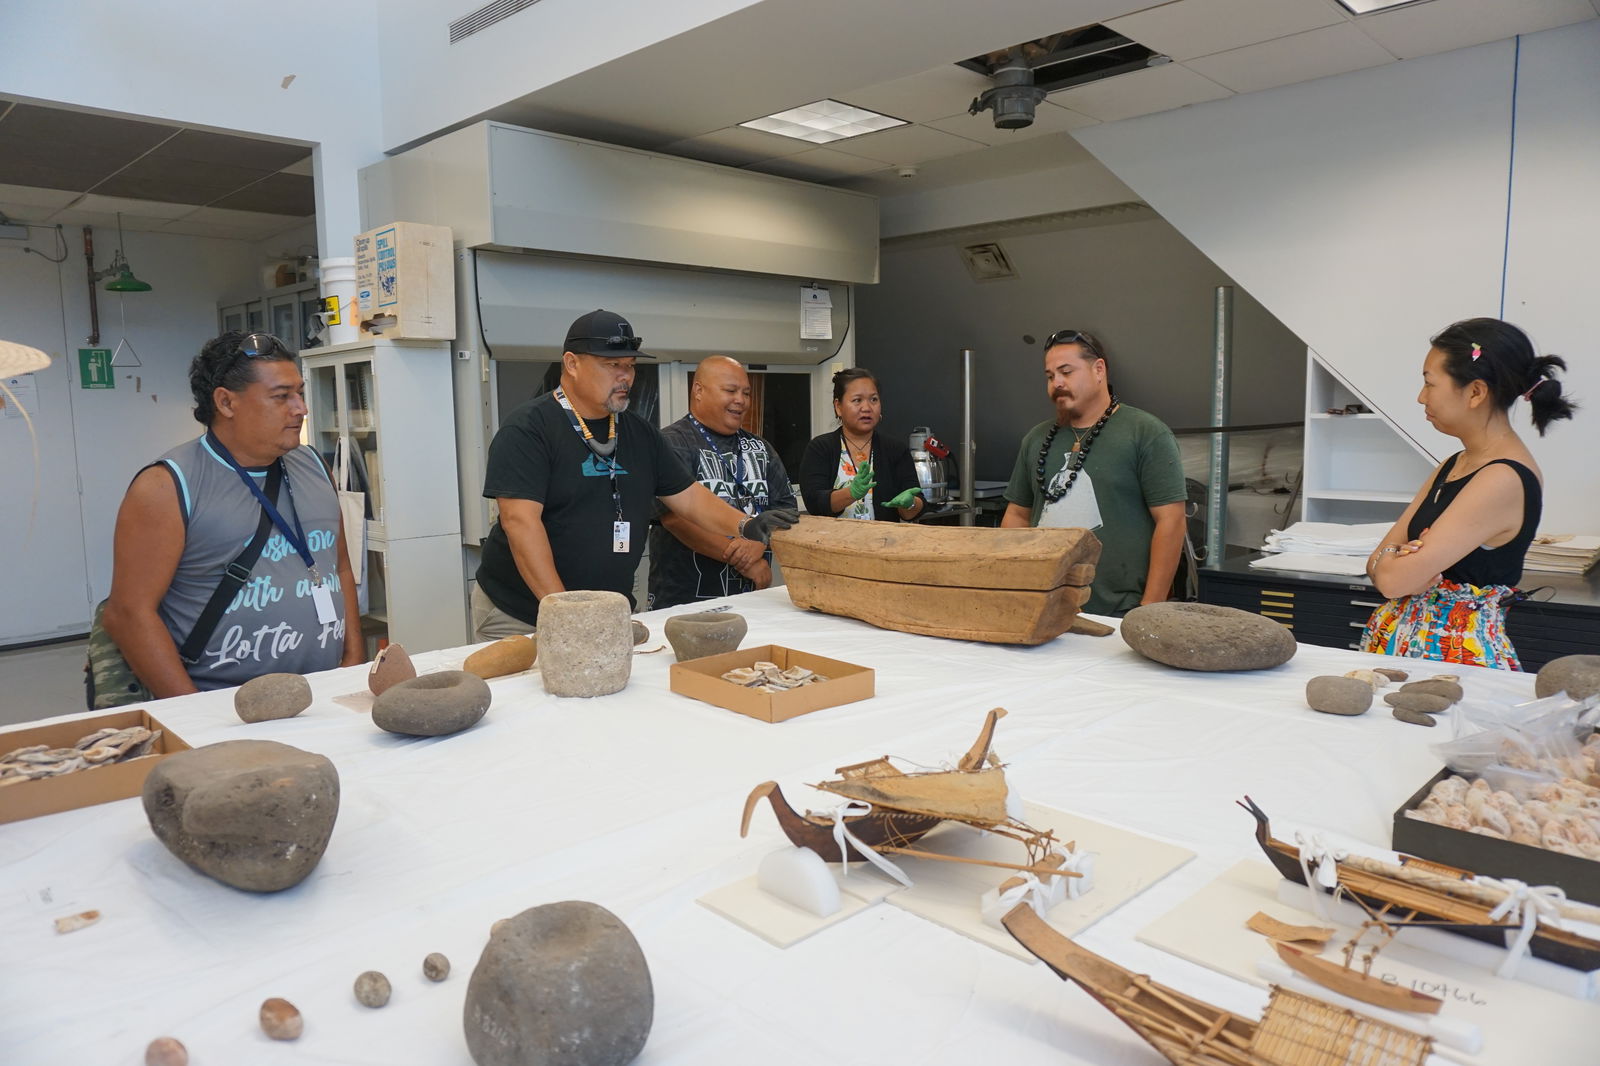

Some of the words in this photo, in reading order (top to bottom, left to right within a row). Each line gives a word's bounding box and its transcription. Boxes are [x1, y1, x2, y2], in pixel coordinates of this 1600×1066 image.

[308, 530, 336, 552] on
[619, 541, 624, 549] 3
[206, 621, 304, 669] Lotta
